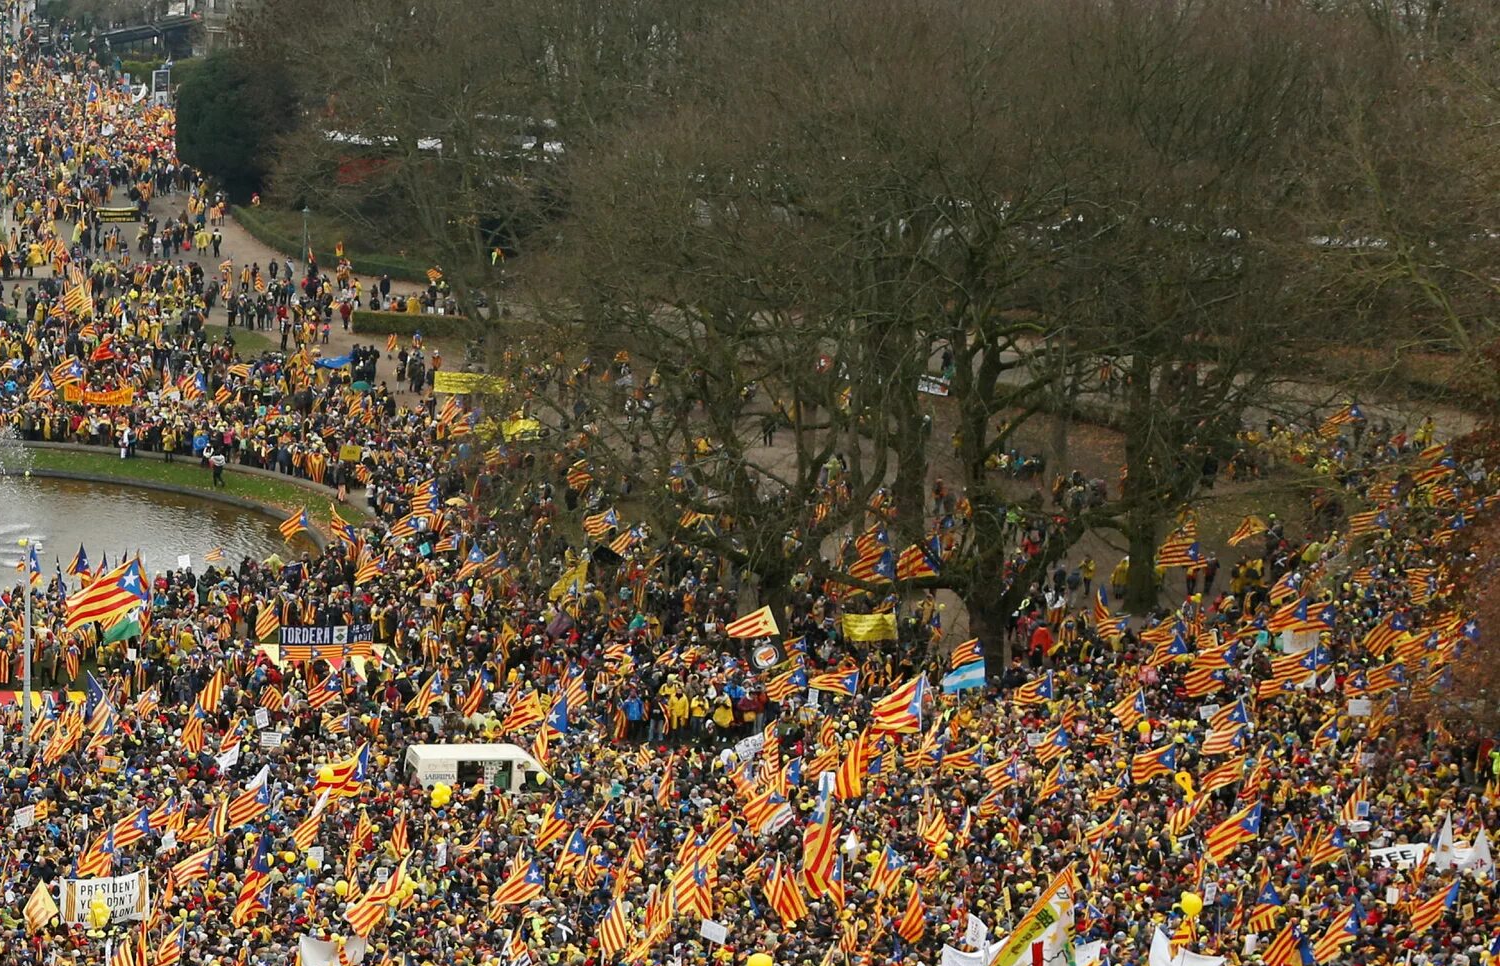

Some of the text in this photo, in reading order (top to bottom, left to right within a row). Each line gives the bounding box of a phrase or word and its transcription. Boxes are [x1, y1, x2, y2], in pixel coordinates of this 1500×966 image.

[281, 626, 330, 644] TORDERA
[81, 879, 135, 896] PRESIDENT
[107, 894, 132, 907] DON'T
